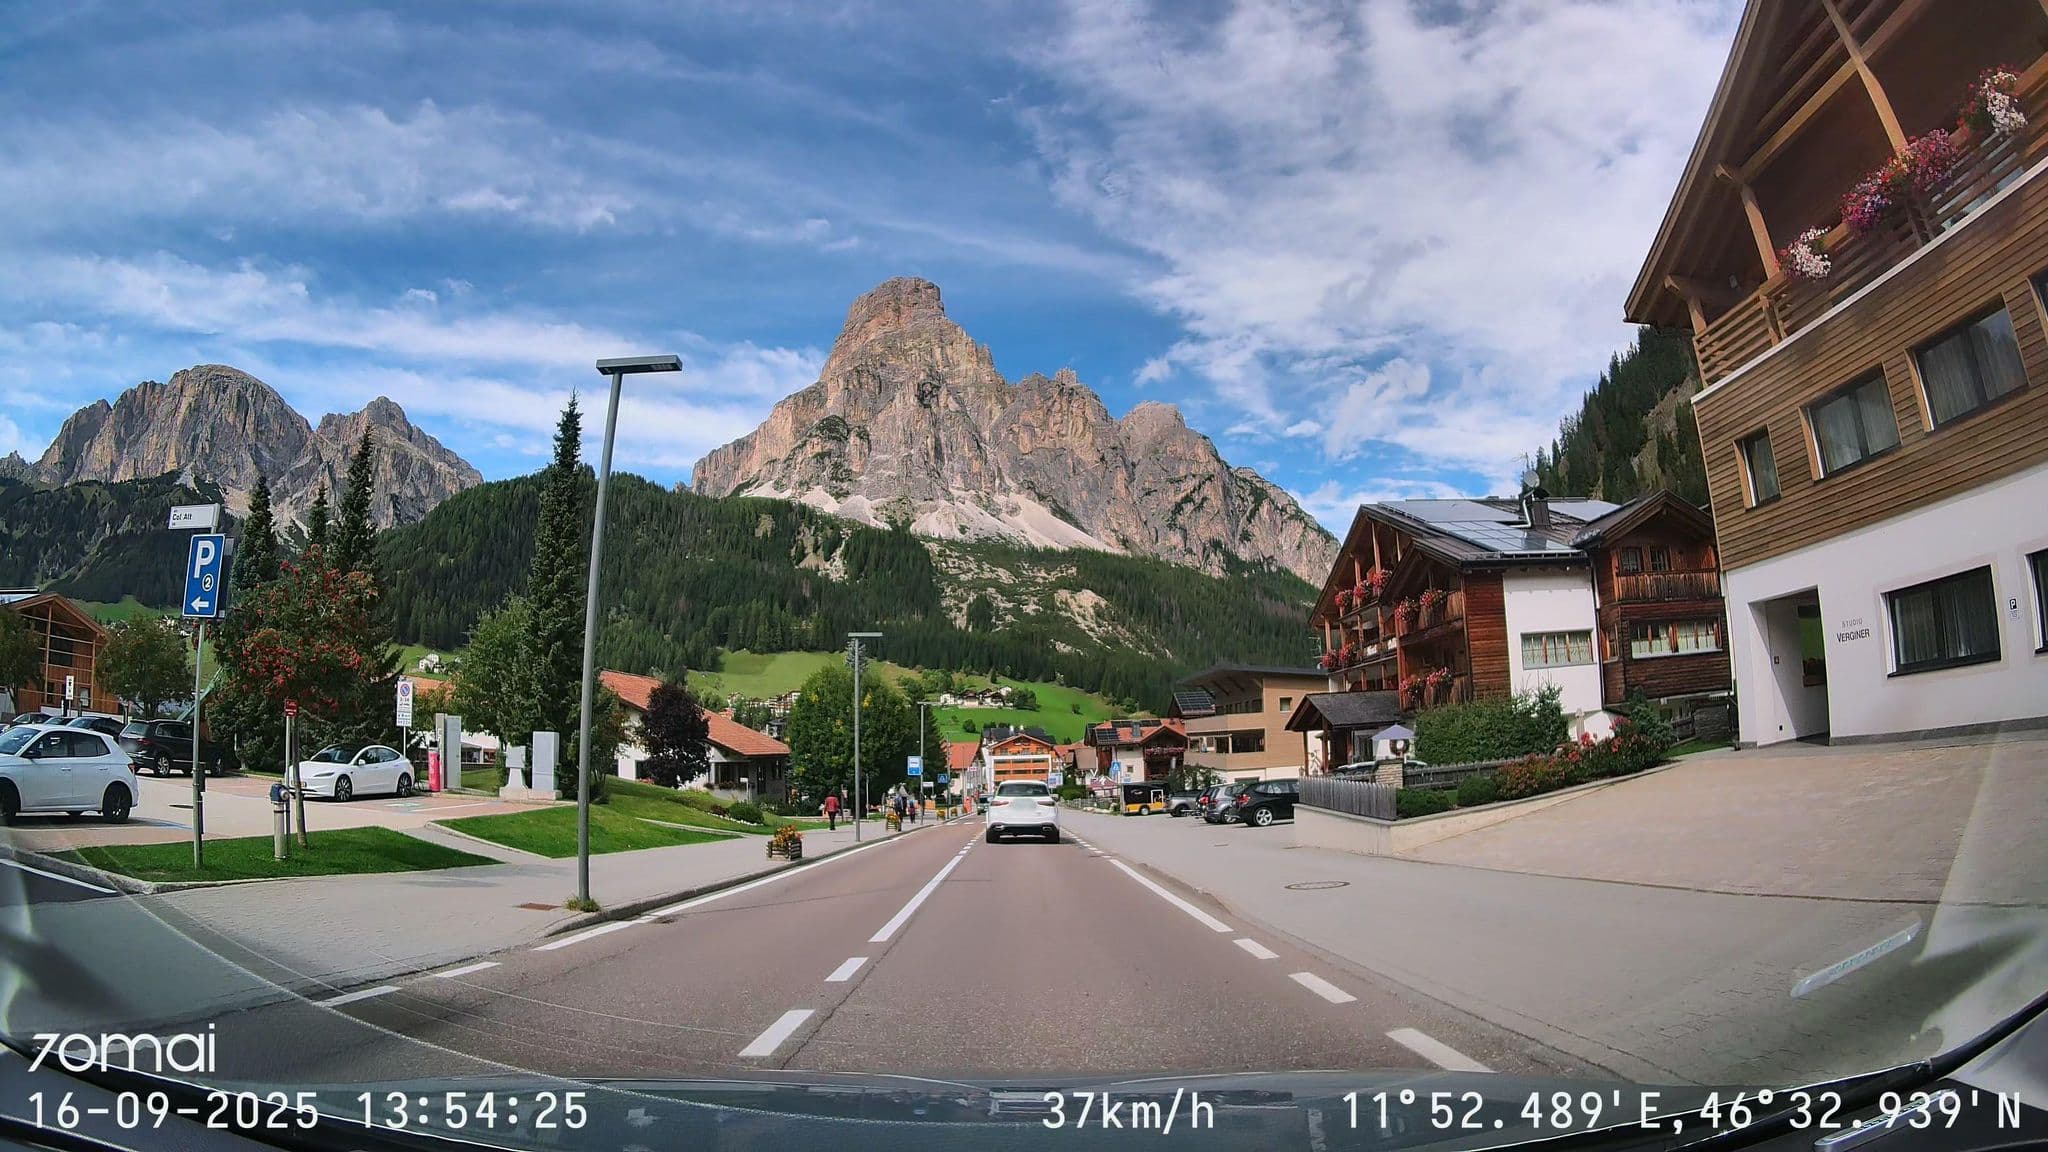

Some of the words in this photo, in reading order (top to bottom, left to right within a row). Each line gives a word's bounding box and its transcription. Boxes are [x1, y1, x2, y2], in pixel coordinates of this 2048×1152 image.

[193, 540, 215, 578] P
[204, 577, 211, 589] 2
[1836, 628, 1870, 642] VERGINER
